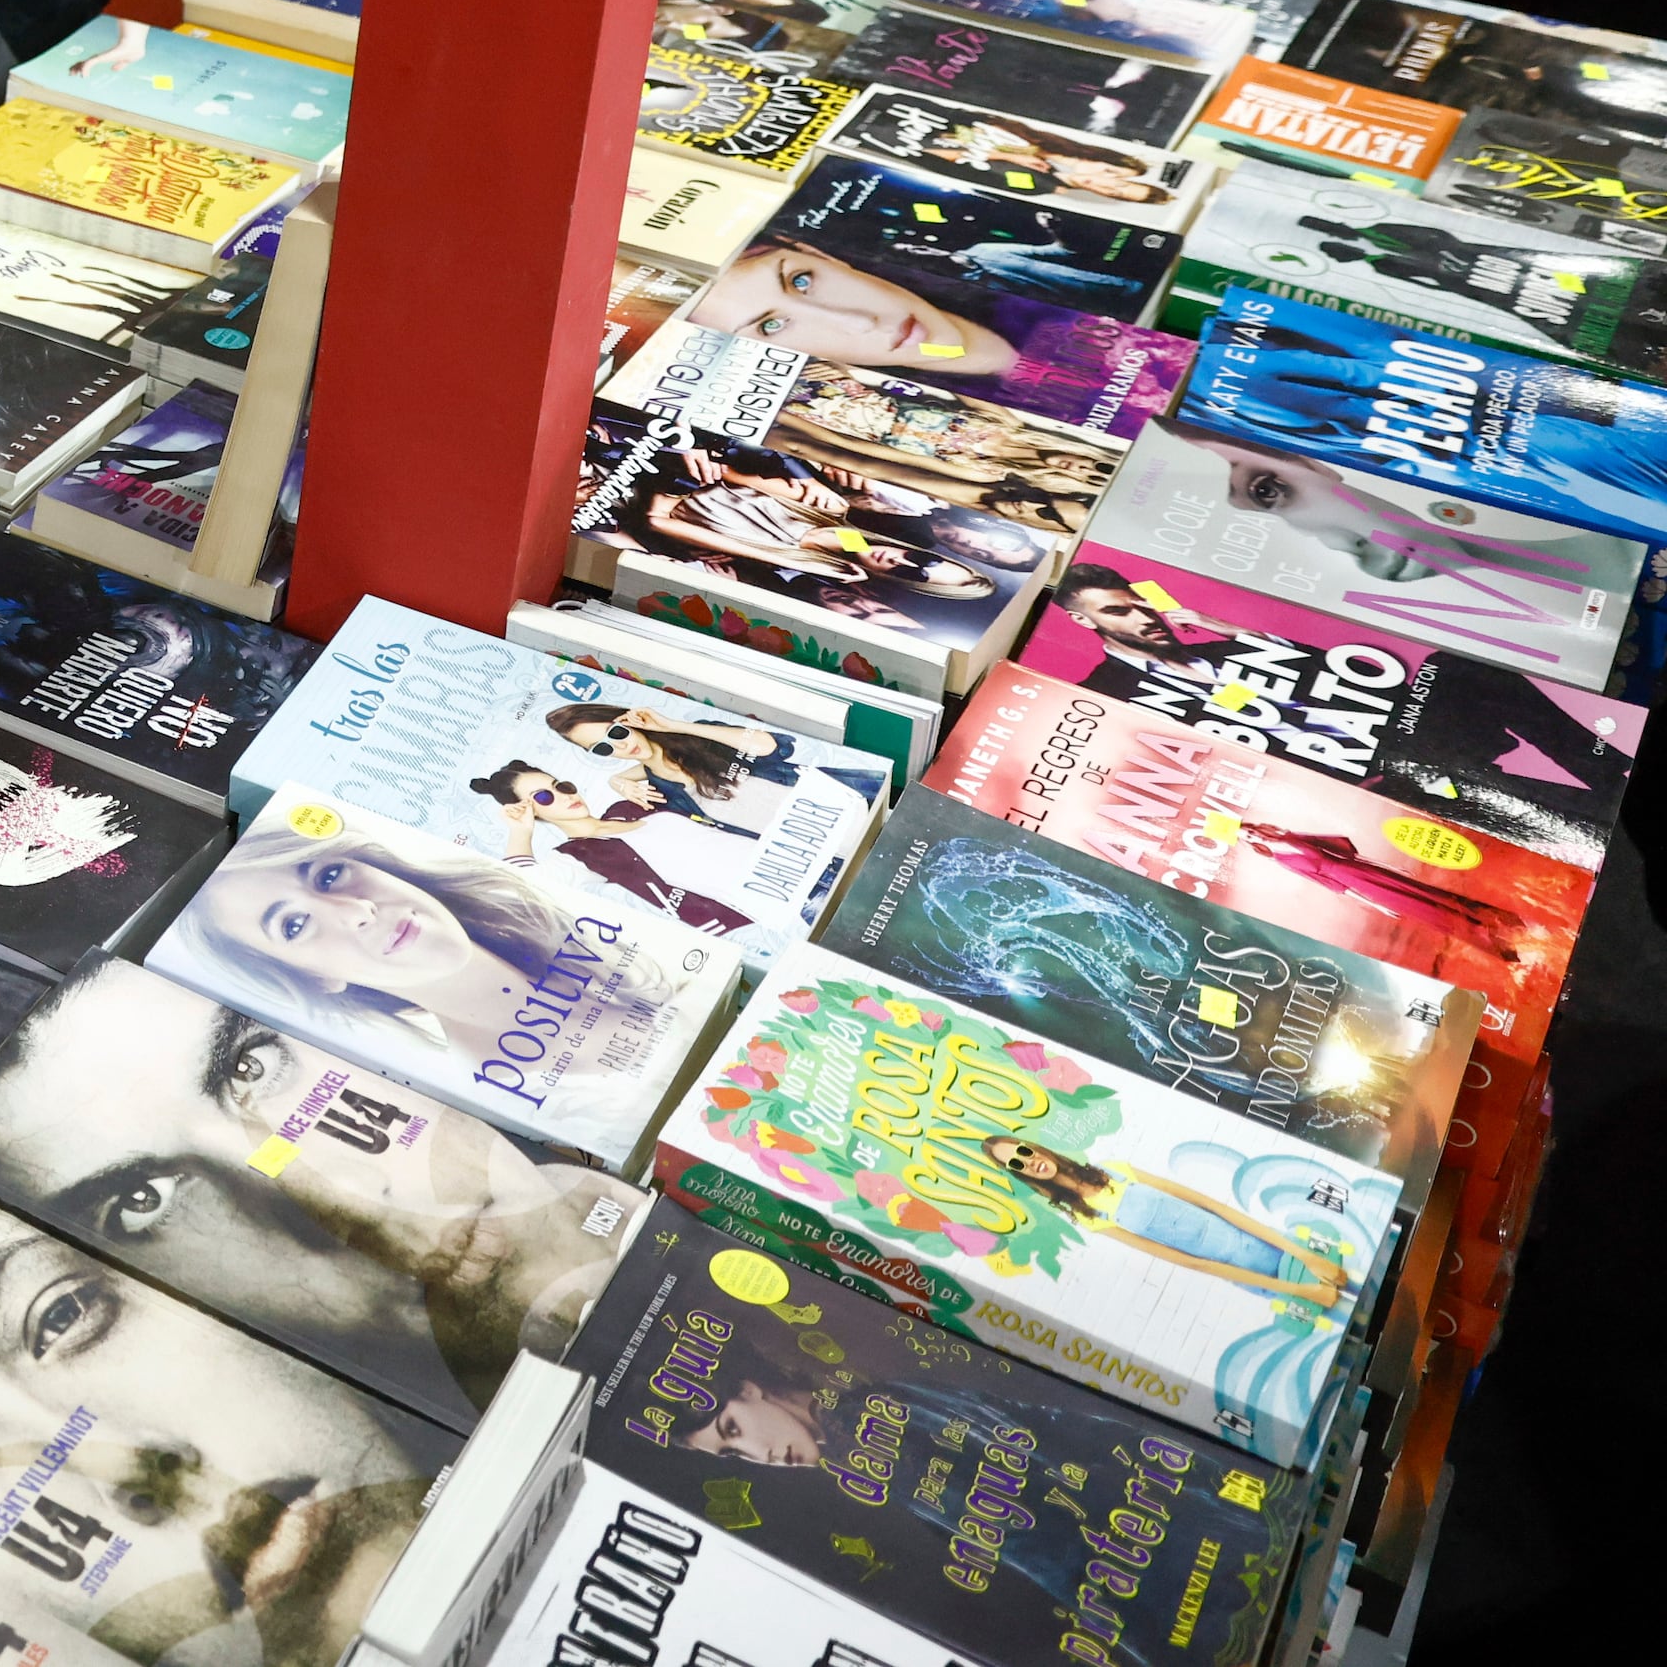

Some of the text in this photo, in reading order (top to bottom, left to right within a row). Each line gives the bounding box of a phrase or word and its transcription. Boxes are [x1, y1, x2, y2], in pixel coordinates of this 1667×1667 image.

[642, 178, 721, 231] Corazón
[1084, 348, 1149, 434] PAULA RAMOS
[1213, 301, 1275, 416] KATY EVANS
[1361, 339, 1486, 472] PECADO
[0, 369, 120, 461] ANNA CAREY
[1165, 490, 1216, 558] LO QUE
[1211, 509, 1279, 573] QUEDA
[1272, 563, 1323, 594] DE
[19, 632, 128, 721] MATARTE
[75, 666, 175, 741] QUIERO
[1285, 642, 1408, 781] RATO
[1395, 661, 1441, 737] JANA ASTON
[948, 726, 1017, 804] JANETH
[1030, 698, 1106, 801] REGRESO
[1081, 760, 1111, 786] DE
[743, 795, 845, 902] DAHLIA ADLER
[1081, 732, 1213, 877] ANNA
[861, 836, 931, 948] SHERRY THOMAS
[471, 911, 624, 1111] positiva
[540, 1051, 574, 1087] diario
[565, 1032, 586, 1049] de
[581, 1005, 602, 1030] una
[595, 971, 624, 1004] chica
[1125, 967, 1174, 1019] LAS
[598, 1032, 640, 1072] PAIGE
[850, 1028, 936, 1157] ROSA
[1245, 961, 1343, 1129] INDÓMITAS
[297, 1068, 352, 1130] HINCKEL
[314, 1086, 413, 1157] U4
[900, 1035, 1049, 1234] SANTOS
[851, 1133, 882, 1171] DE
[779, 1212, 1189, 1408] NO TE Enamores DE ROSA SANTOS
[623, 1307, 735, 1450] La guía
[14, 1404, 99, 1510] VILLEMINOT
[813, 1392, 911, 1508] dama
[910, 1416, 972, 1516] para las
[943, 1422, 1041, 1594] enaguas
[1058, 1431, 1198, 1667] piratería
[1200, 1536, 1223, 1577] LEE
